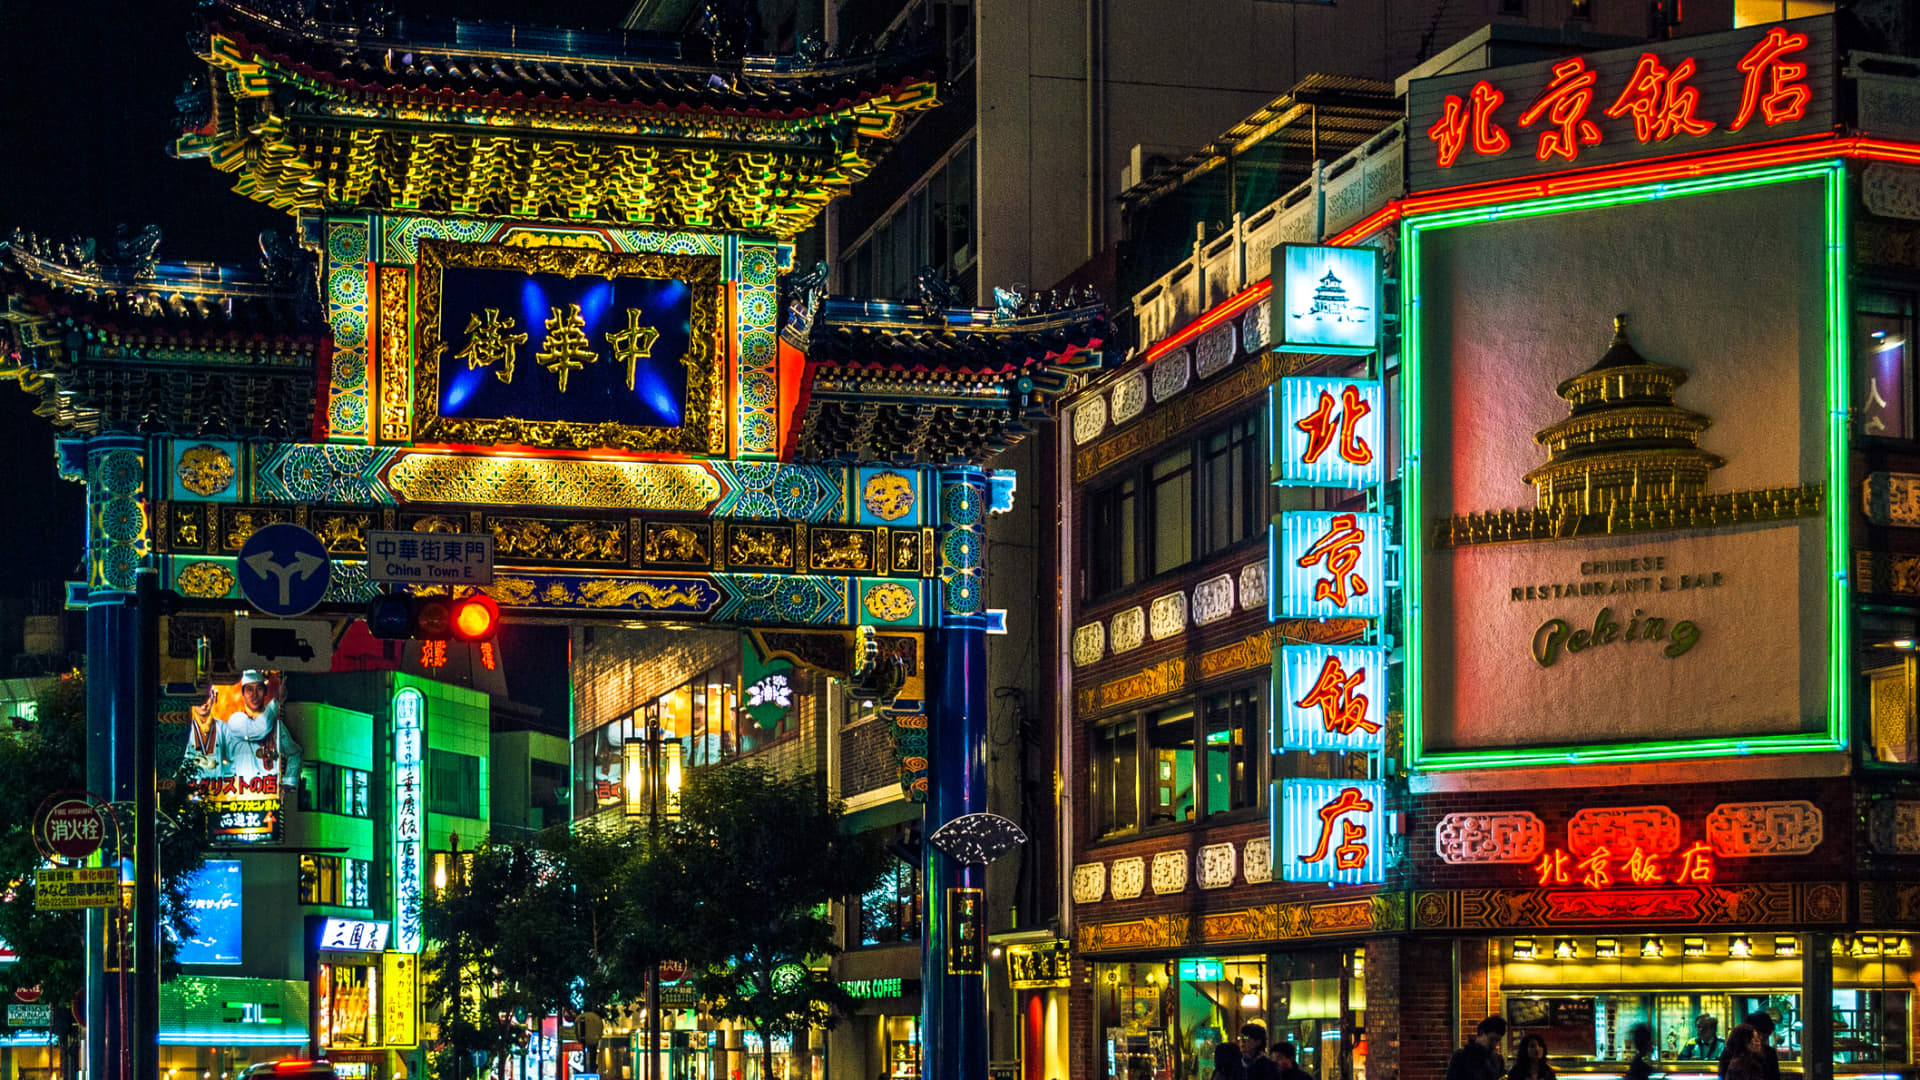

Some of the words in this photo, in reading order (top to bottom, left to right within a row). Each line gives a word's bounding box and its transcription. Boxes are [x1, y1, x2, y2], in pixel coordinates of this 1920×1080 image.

[1427, 27, 1812, 168] 北京飯店
[375, 538, 486, 563] 中華街東門
[386, 563, 421, 577] China
[427, 565, 459, 578] Town
[1580, 556, 1665, 576] CHINESE
[1510, 577, 1650, 601] RESTAURANT
[1659, 575, 1674, 592] &
[1680, 571, 1724, 590] BAR
[1296, 384, 1384, 870] 北京飯店
[1531, 607, 1702, 668] Peking
[51, 818, 99, 841] 消火栓
[1535, 841, 1716, 889] 北京飯店
[38, 881, 115, 897] みなと国際事務所
[183, 899, 239, 910] ツ矢サイダー
[838, 979, 871, 999] BUCKS
[872, 977, 902, 998] COFFEE
